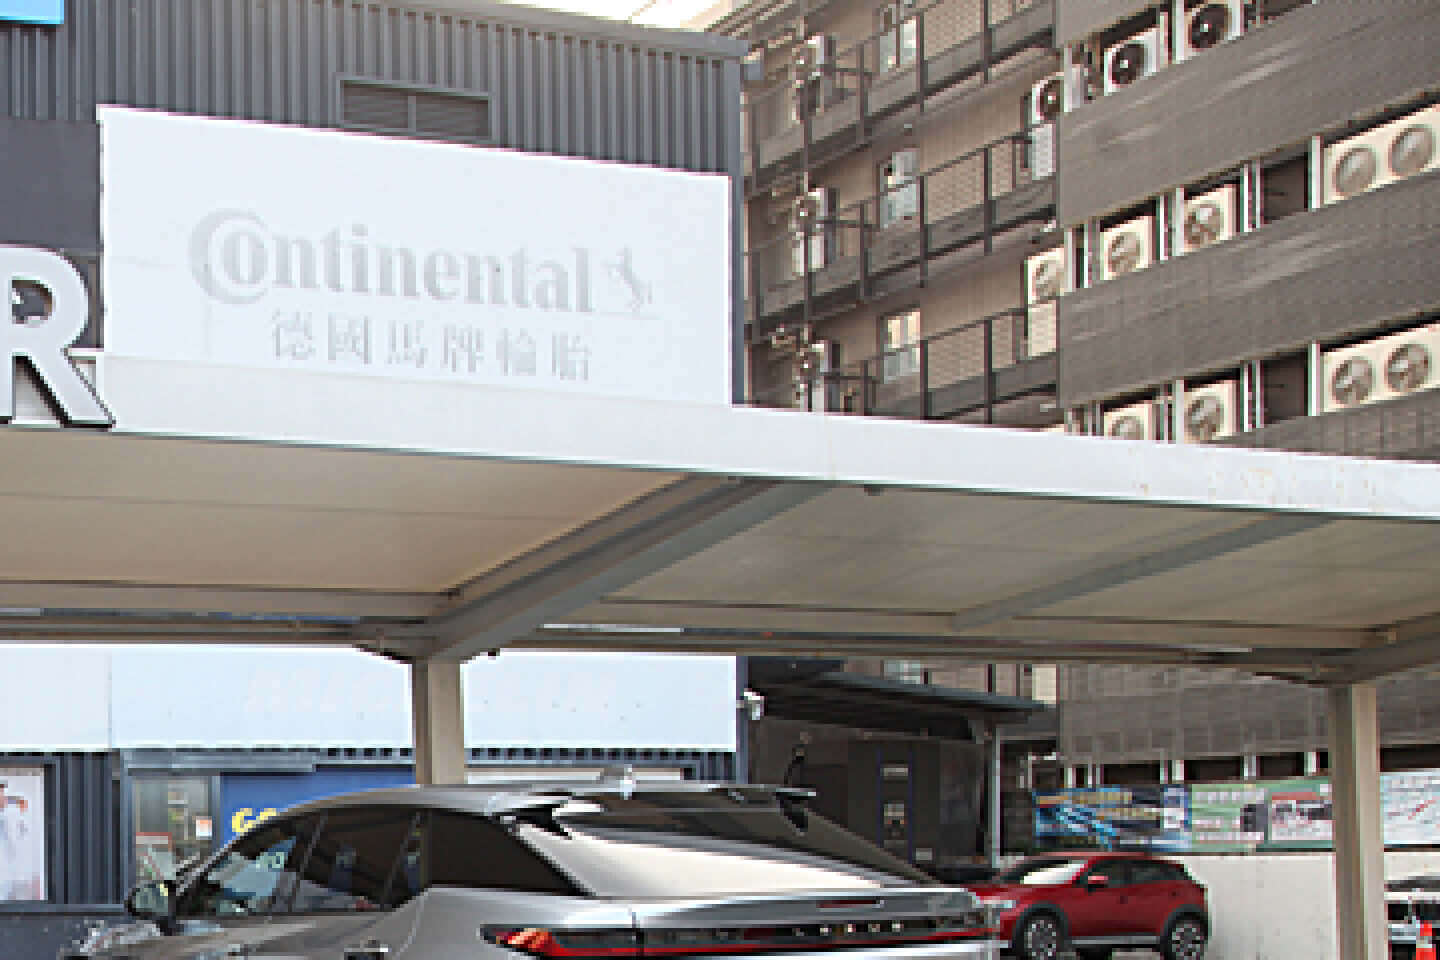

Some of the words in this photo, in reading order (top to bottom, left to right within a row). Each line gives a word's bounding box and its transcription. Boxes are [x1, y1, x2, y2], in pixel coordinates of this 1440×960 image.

[189, 208, 594, 313] Continental
[271, 310, 592, 382] 德國馬牌輪胎
